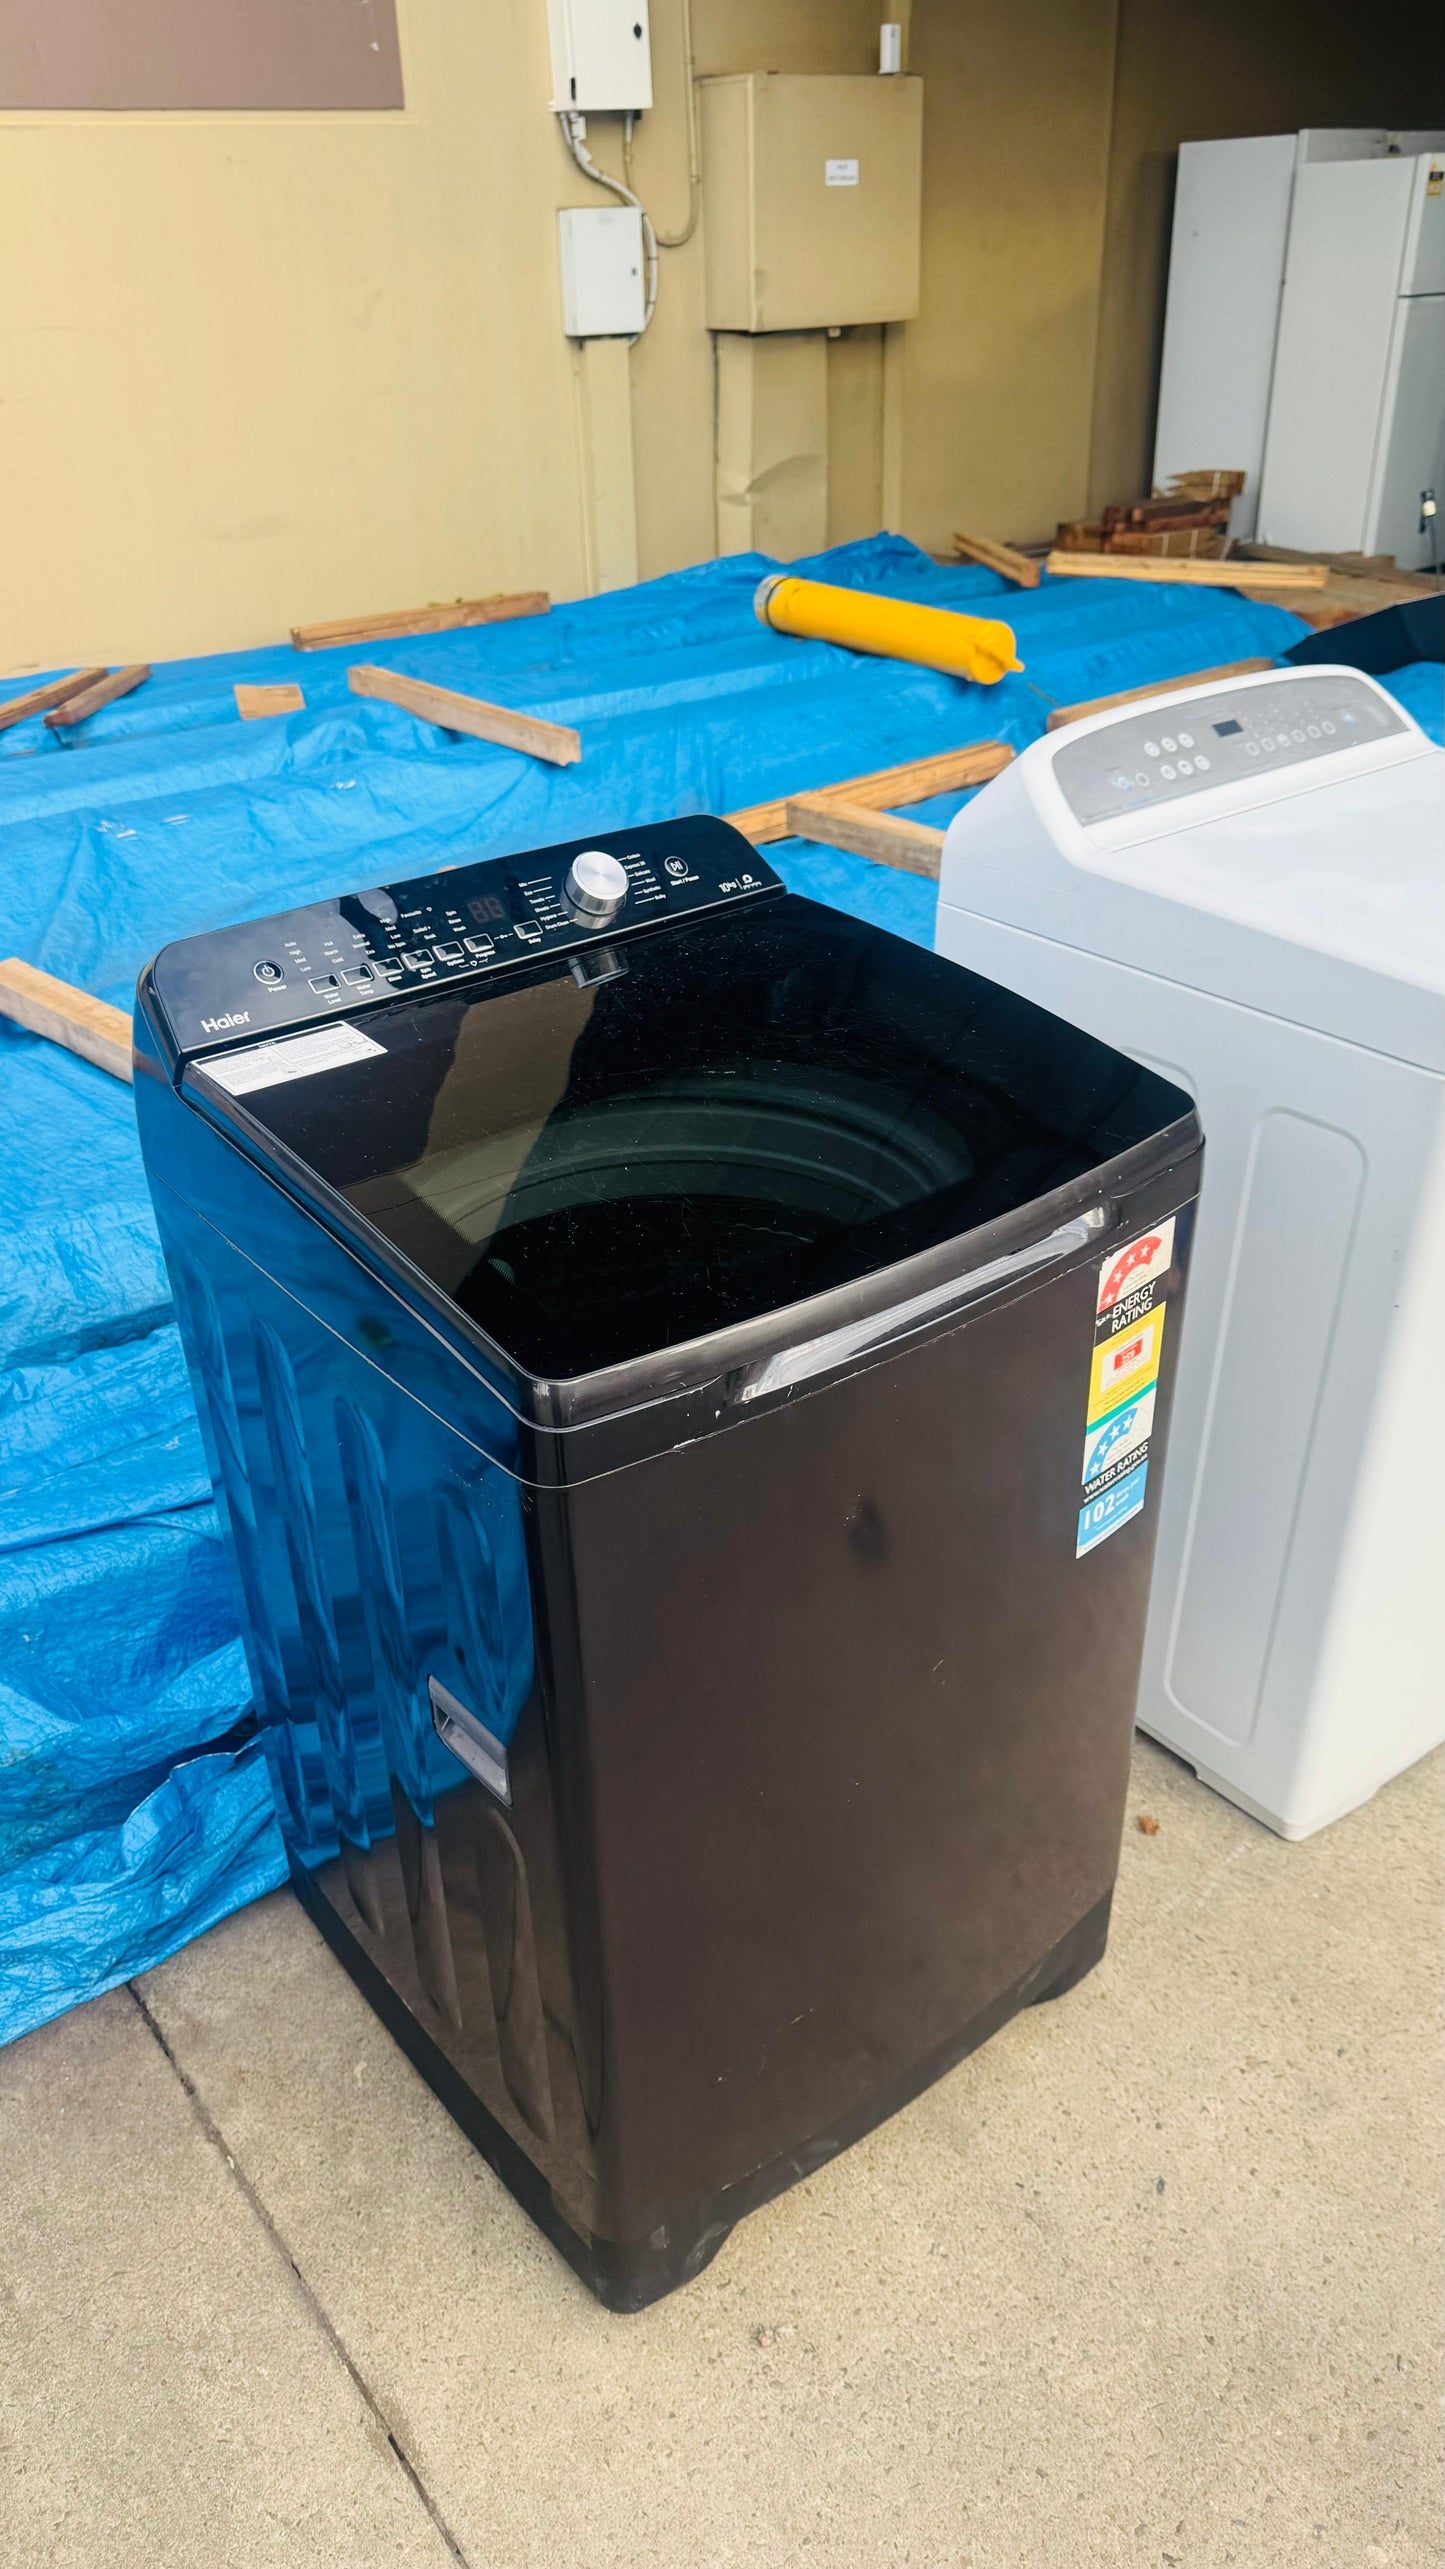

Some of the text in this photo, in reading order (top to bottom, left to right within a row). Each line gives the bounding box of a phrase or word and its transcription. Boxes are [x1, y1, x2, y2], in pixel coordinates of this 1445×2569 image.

[718, 881, 738, 893] 10kg
[267, 984, 287, 993] Power
[200, 1011, 251, 1033] Haier
[1111, 1297, 1153, 1333] RATING
[1112, 1280, 1157, 1319] ENERGY
[1084, 1467, 1117, 1495] WATER
[1116, 1441, 1149, 1473] RATING
[1084, 1493, 1116, 1530] 102
